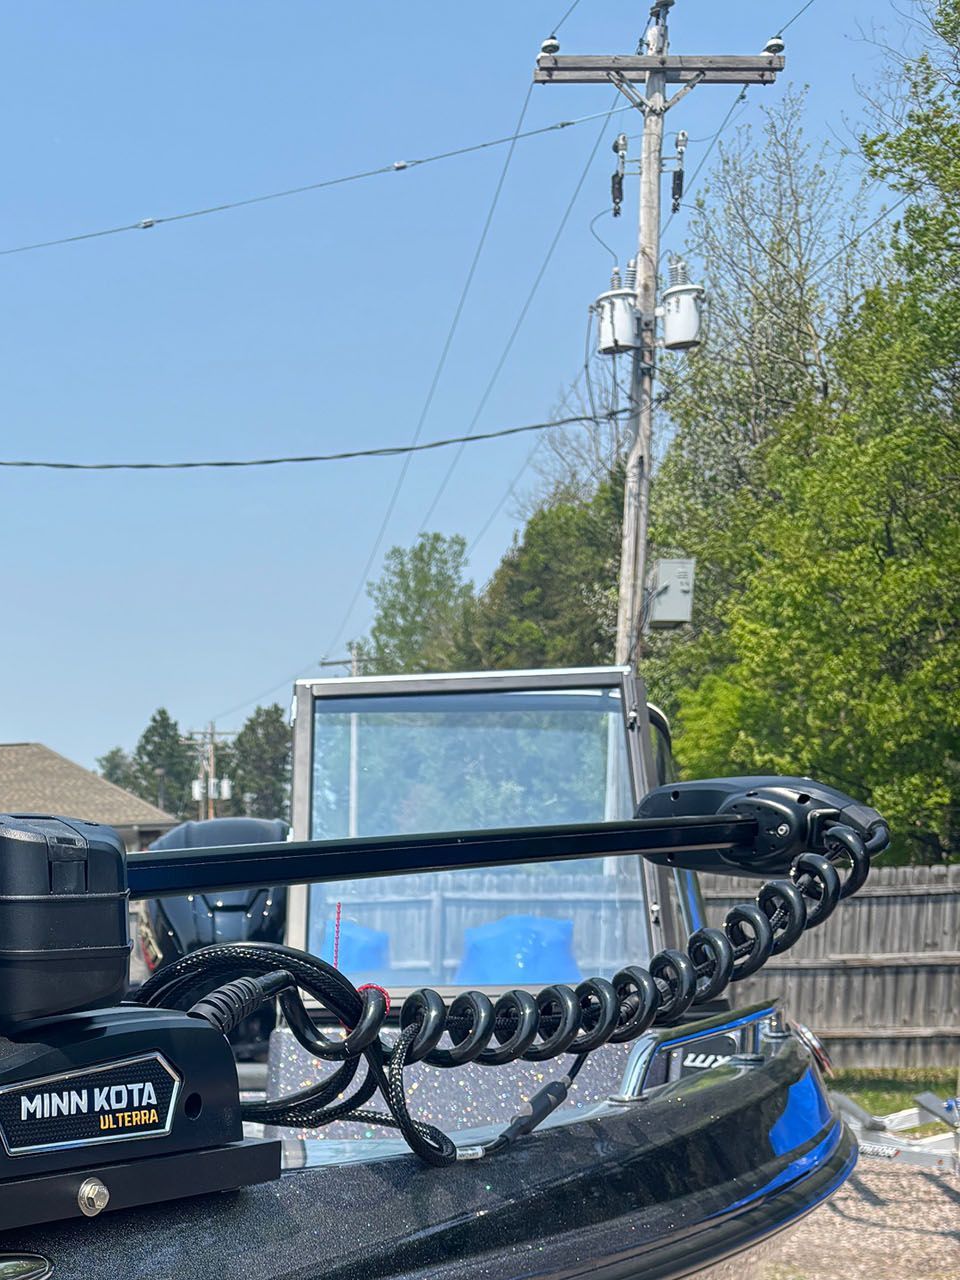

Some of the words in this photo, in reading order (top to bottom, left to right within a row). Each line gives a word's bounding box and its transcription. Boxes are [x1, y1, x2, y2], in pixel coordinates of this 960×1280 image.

[20, 1088, 89, 1121] MINN
[93, 1081, 158, 1111] KOTA
[99, 1108, 159, 1130] ULTERRA
